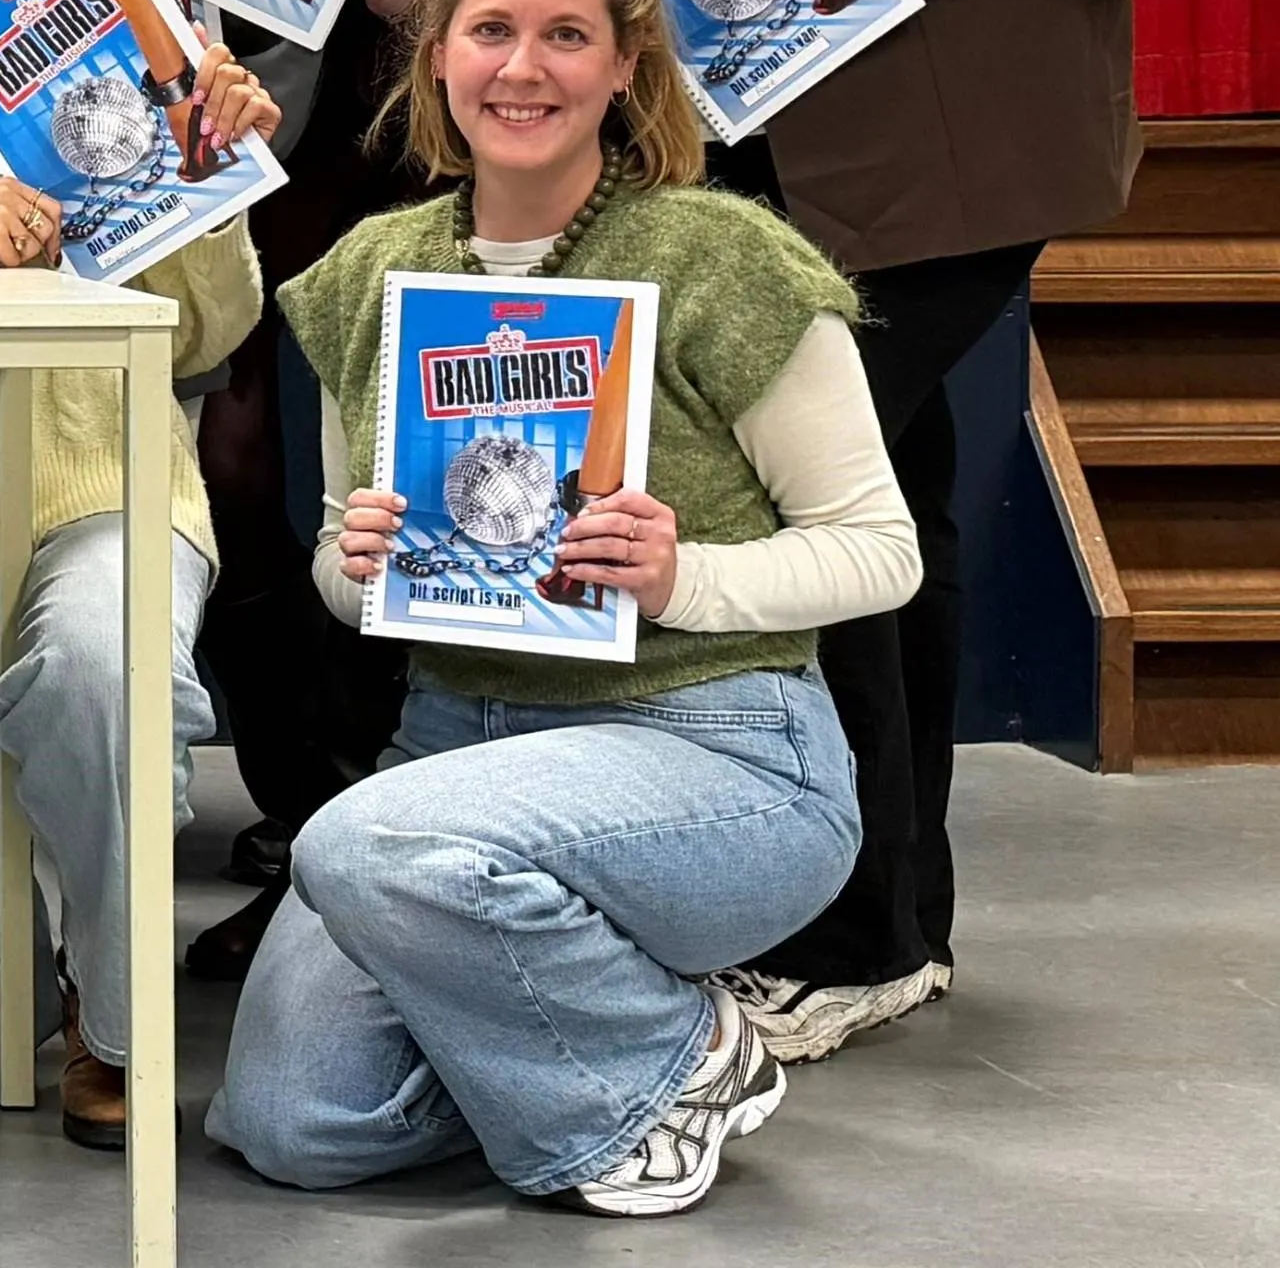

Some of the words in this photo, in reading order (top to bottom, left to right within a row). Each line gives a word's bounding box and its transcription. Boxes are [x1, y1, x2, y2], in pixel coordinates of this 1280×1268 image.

[729, 75, 750, 96] Dit
[748, 51, 784, 83] script
[781, 43, 796, 58] is
[86, 236, 108, 257] Dit
[106, 214, 143, 244] script
[142, 207, 157, 222] is
[434, 357, 495, 407] BAD
[500, 349, 588, 402] GIRLS
[409, 582, 428, 599] Dit
[433, 586, 476, 606] script
[479, 587, 492, 605] is
[496, 591, 526, 609] van:
